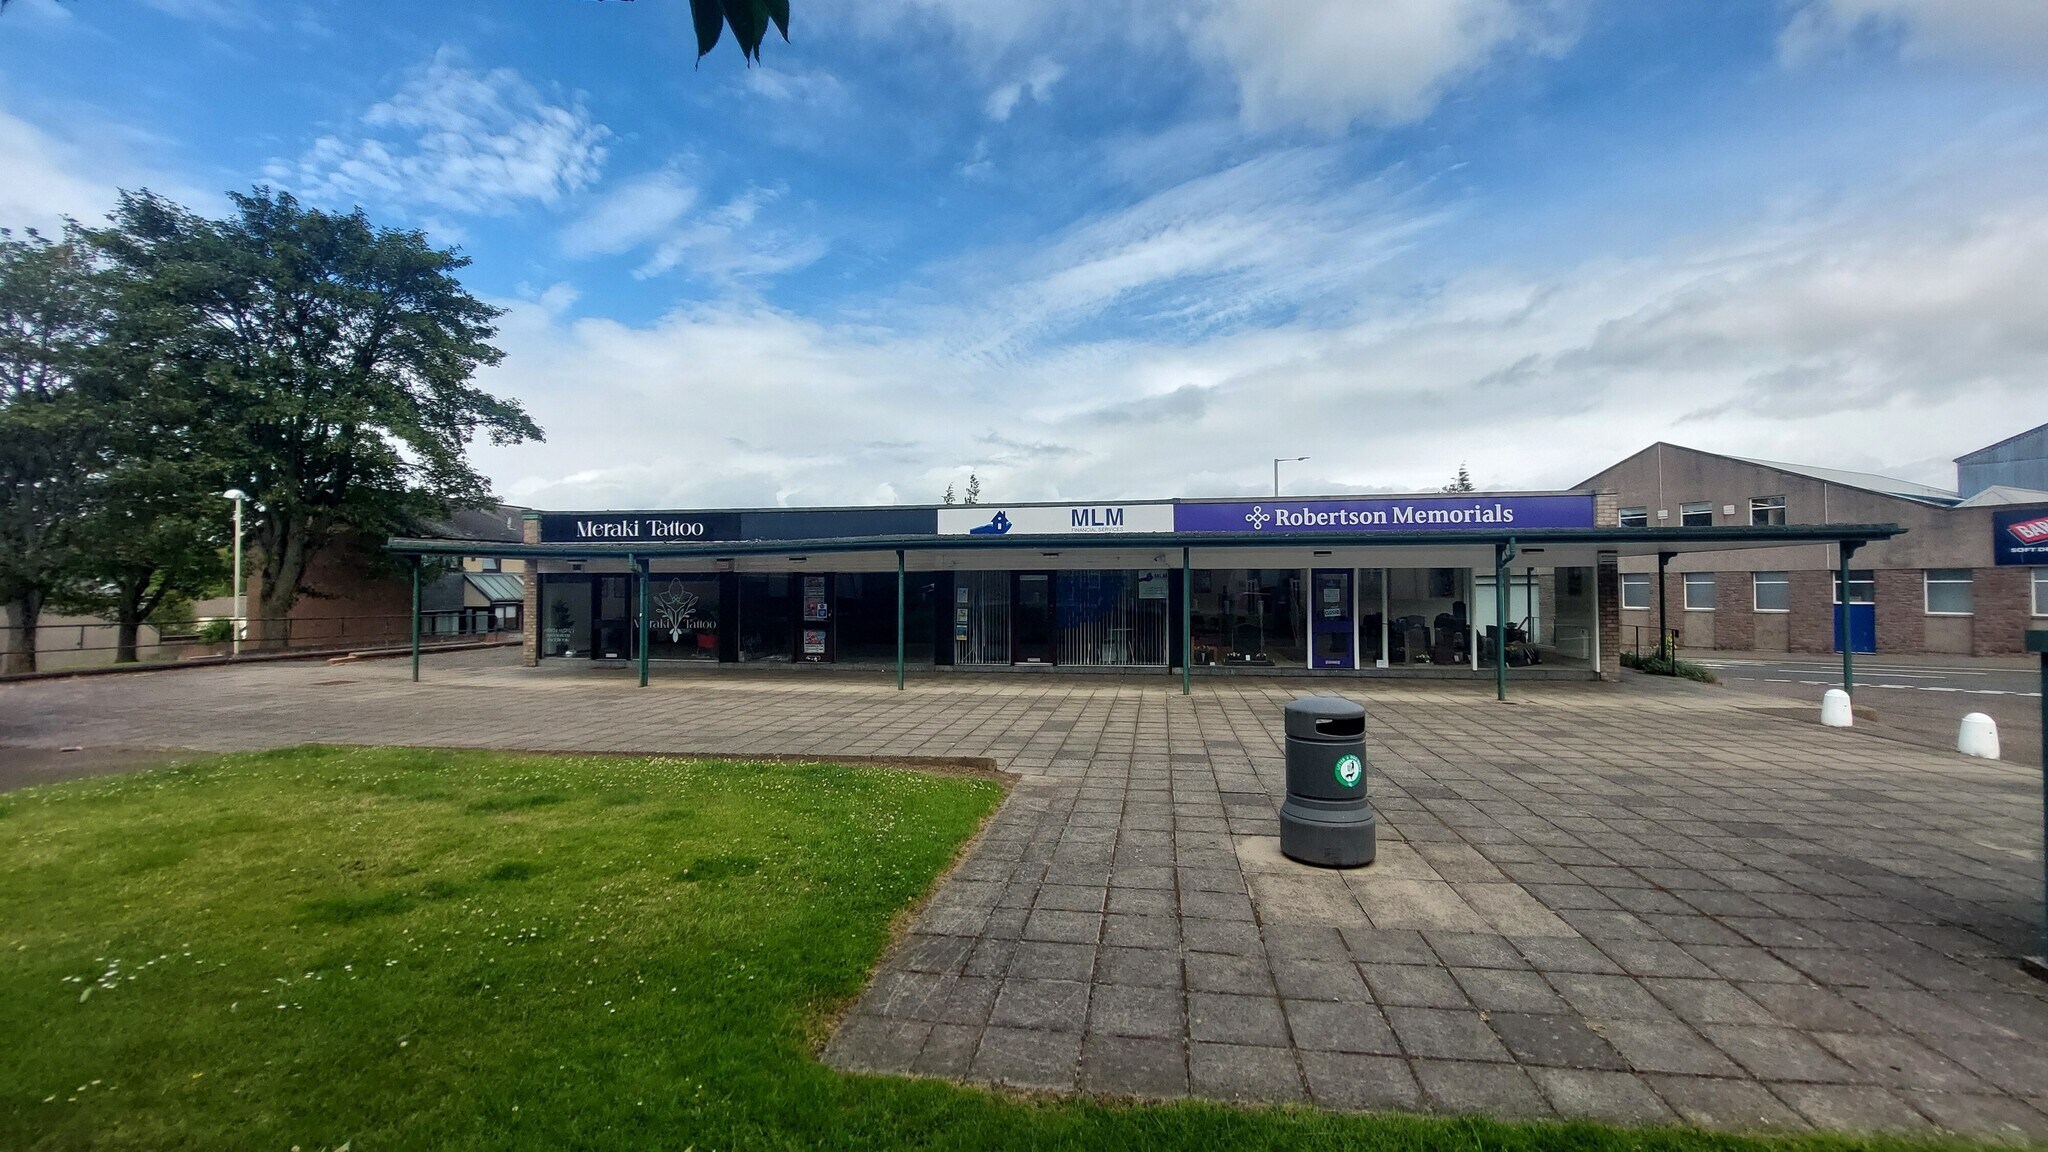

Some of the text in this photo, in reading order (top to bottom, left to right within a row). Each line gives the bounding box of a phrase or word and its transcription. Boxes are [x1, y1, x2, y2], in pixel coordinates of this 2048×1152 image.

[1071, 508, 1124, 526] MLM
[1275, 504, 1514, 526] Robertson Memorials
[576, 520, 704, 537] Meraki Tattoo
[2014, 519, 2048, 538] BAR
[633, 618, 717, 629] raki Tattoo
